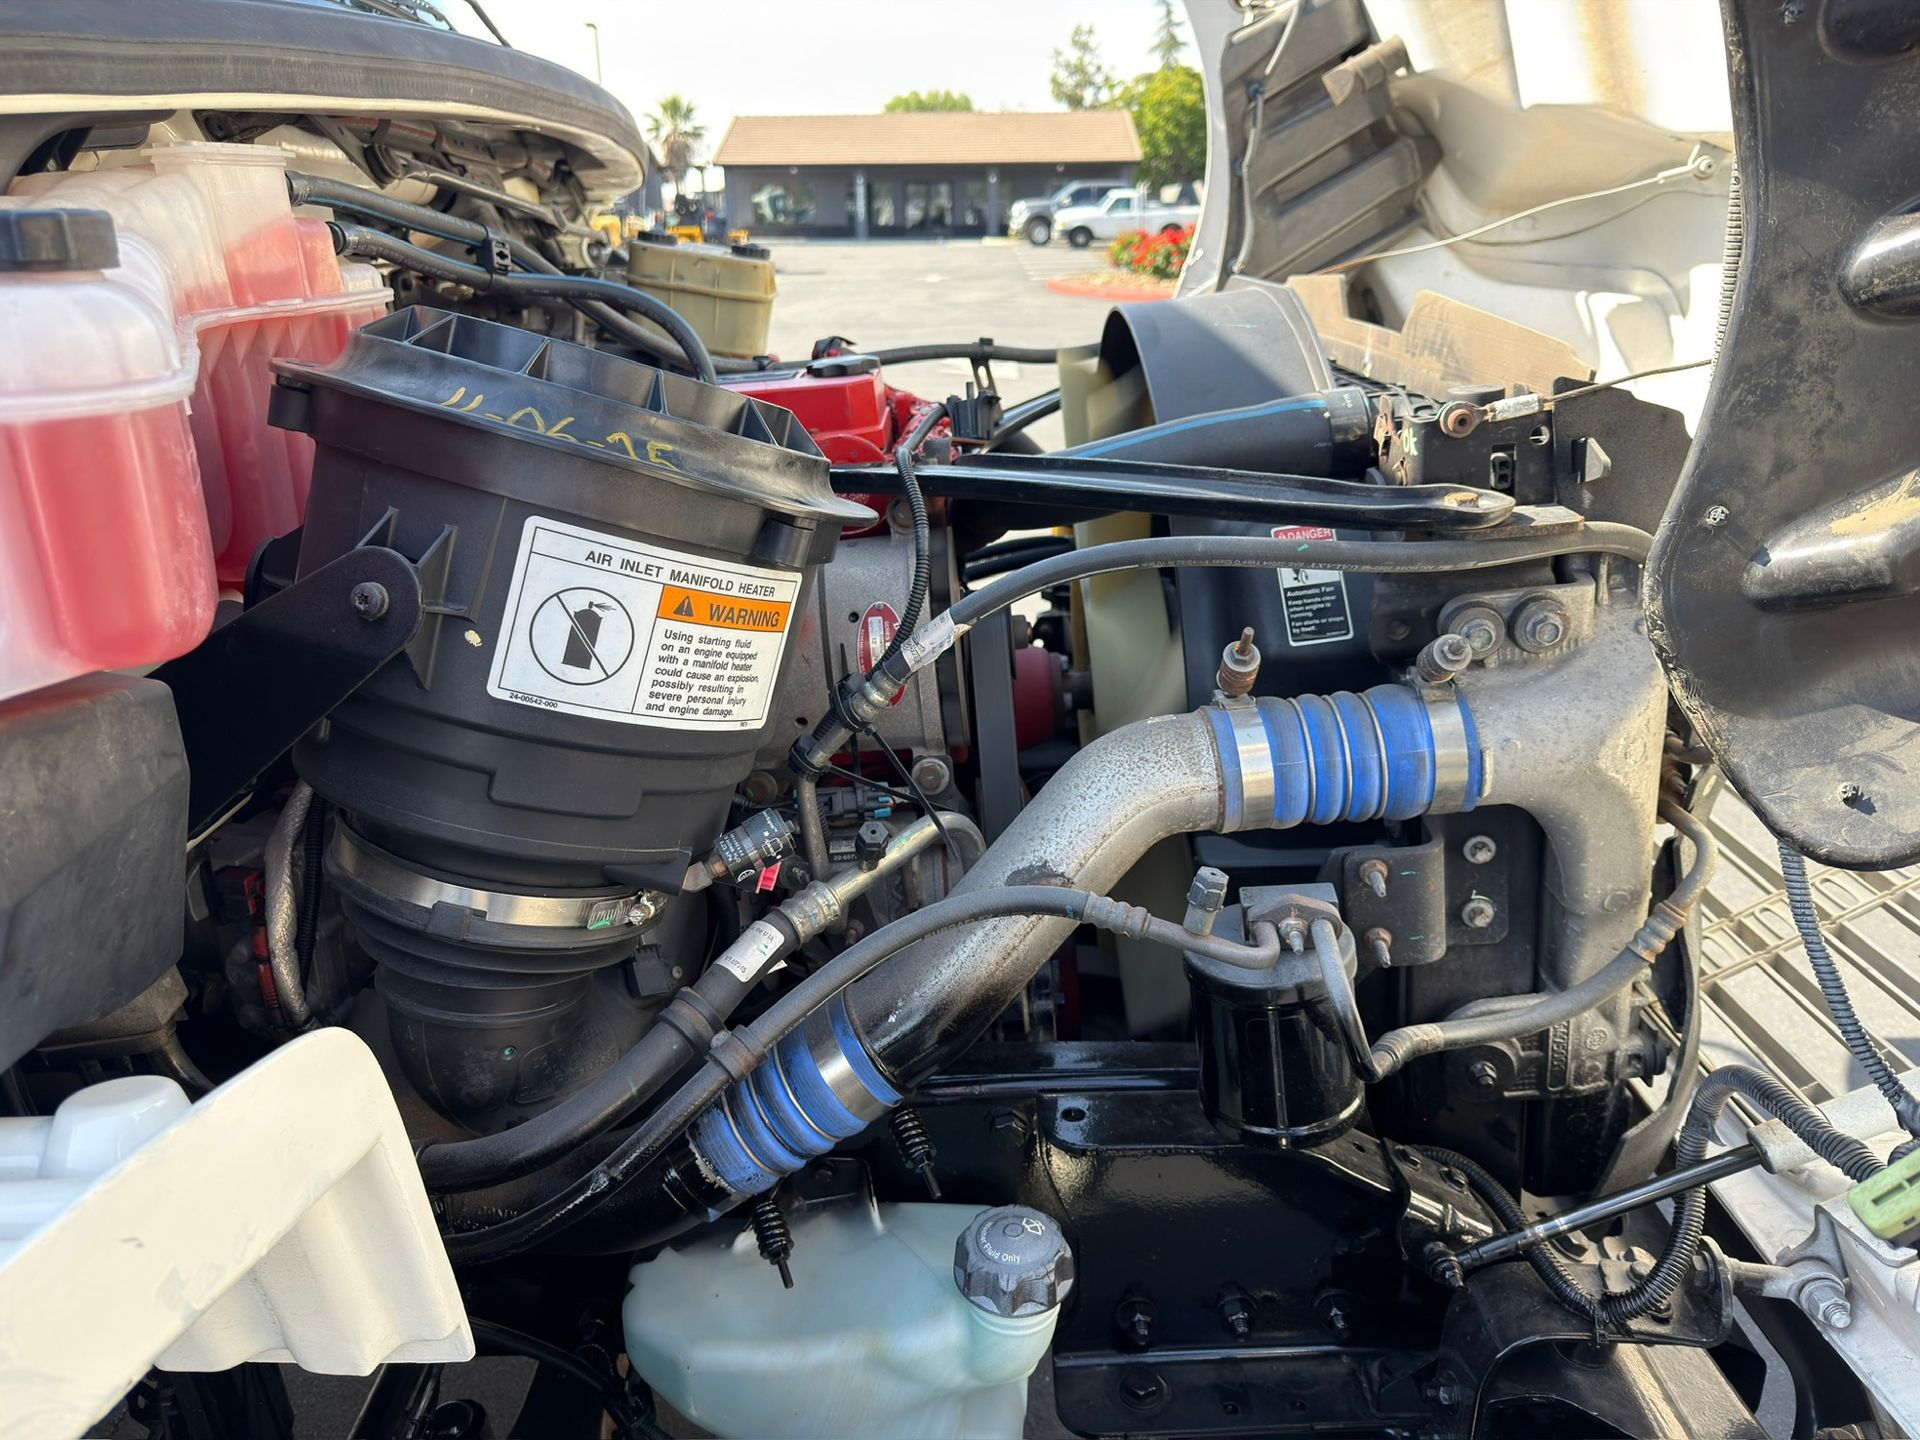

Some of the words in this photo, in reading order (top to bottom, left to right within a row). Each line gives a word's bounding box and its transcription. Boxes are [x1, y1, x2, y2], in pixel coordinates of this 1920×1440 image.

[1287, 528, 1332, 540] DANGER
[585, 550, 613, 566] AIR
[620, 558, 664, 578] INLET
[670, 570, 734, 592] MANIFOLD
[739, 583, 775, 598] HEATER
[1287, 588, 1320, 597] Automatic
[709, 603, 780, 628] WARNING
[664, 629, 693, 644] Using
[698, 635, 731, 650] starting
[734, 638, 752, 649] fluid
[661, 642, 674, 652] on
[678, 645, 691, 654] an
[694, 647, 723, 660] engine
[725, 650, 758, 661] equipped
[658, 653, 679, 665] with
[682, 658, 689, 666] a
[692, 657, 729, 672] manifold
[731, 661, 752, 672] heater
[655, 666, 682, 678] could
[686, 671, 711, 681] cause
[714, 673, 724, 682] an
[651, 678, 695, 693] possibly
[698, 685, 734, 697] resulting
[737, 685, 744, 693] in
[509, 692, 558, 709] 24-00542-000
[649, 691, 682, 702] severe
[686, 695, 723, 707] personal
[726, 696, 746, 708] injury
[645, 701, 664, 711] and
[669, 704, 699, 717] engine
[702, 706, 734, 718] damage.
[983, 1242, 1000, 1260] Fluid
[1002, 1252, 1020, 1264] Only
